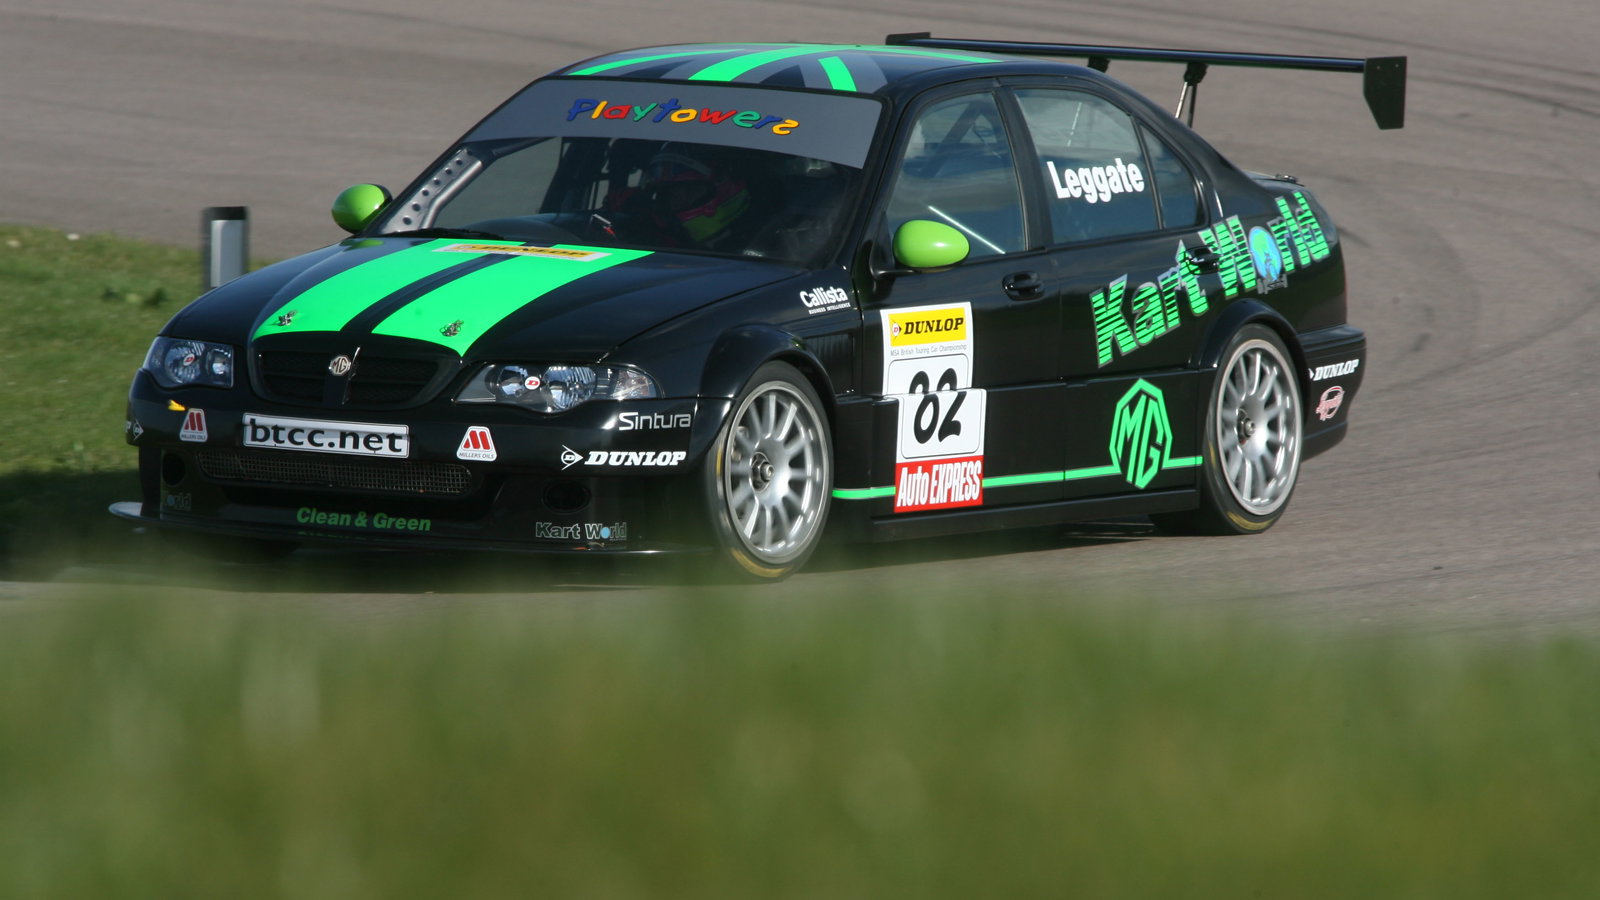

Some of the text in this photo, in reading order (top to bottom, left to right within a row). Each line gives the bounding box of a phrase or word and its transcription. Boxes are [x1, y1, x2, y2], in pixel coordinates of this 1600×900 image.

[567, 99, 800, 135] Playtowers
[1047, 158, 1145, 204] Leggate
[1090, 190, 1331, 368] Kart World
[800, 286, 849, 307] Callista
[904, 317, 964, 334] DUNLOP
[1313, 359, 1360, 381] DUNLOP
[908, 367, 967, 444] 82
[250, 418, 403, 452] btcc.net
[618, 412, 692, 431] Sintura
[1115, 392, 1164, 489] MG
[584, 451, 687, 466] DUNLOP
[896, 459, 982, 507] Auto EXPRESS
[296, 507, 431, 532] Clean & Green
[535, 521, 628, 540] Kart World
